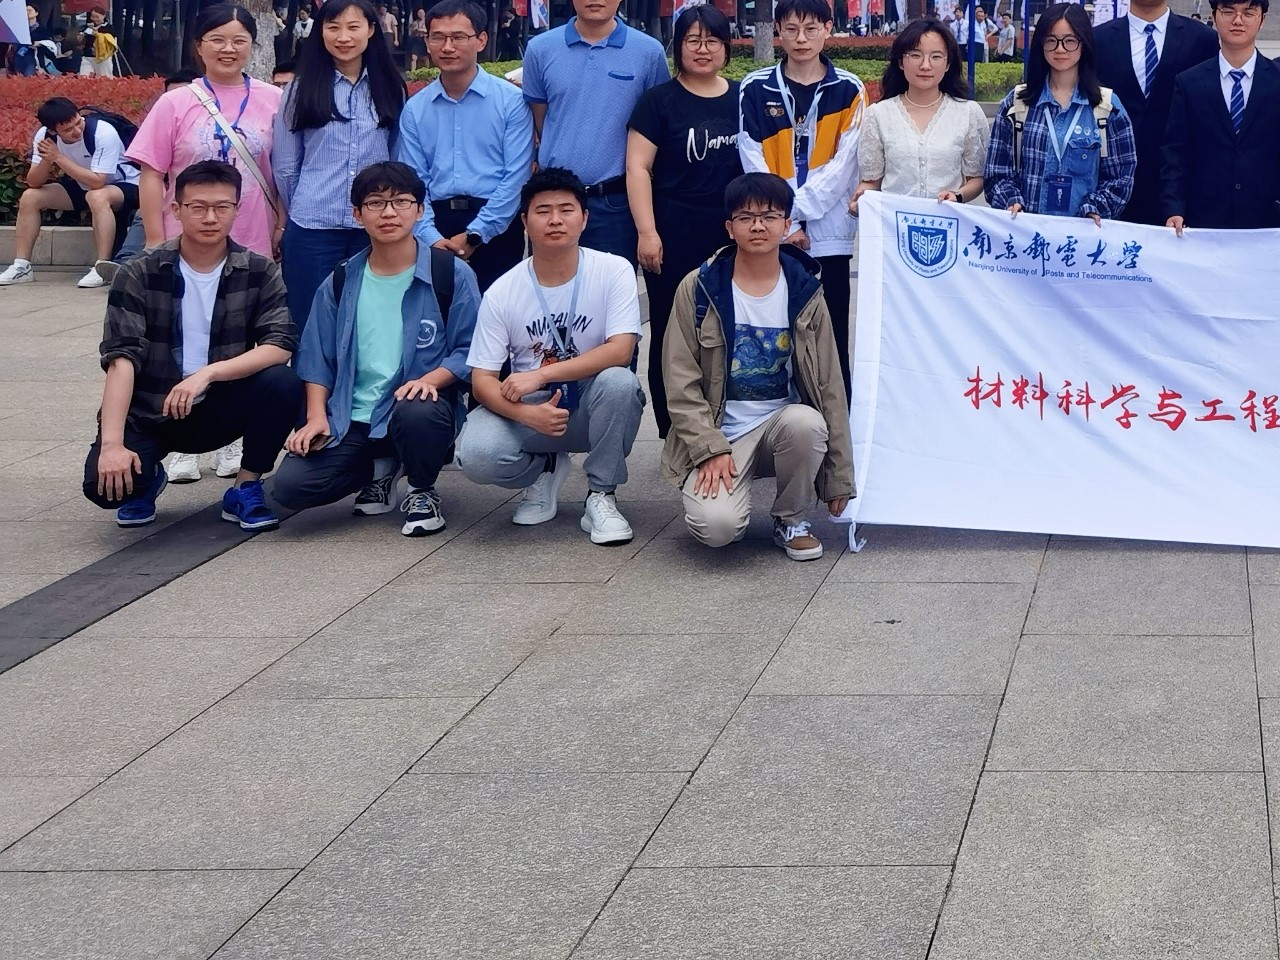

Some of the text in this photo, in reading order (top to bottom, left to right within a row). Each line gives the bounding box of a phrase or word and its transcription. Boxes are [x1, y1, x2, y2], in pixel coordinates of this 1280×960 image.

[968, 260, 1153, 283] Nanjing University of Posts and Telecommunications
